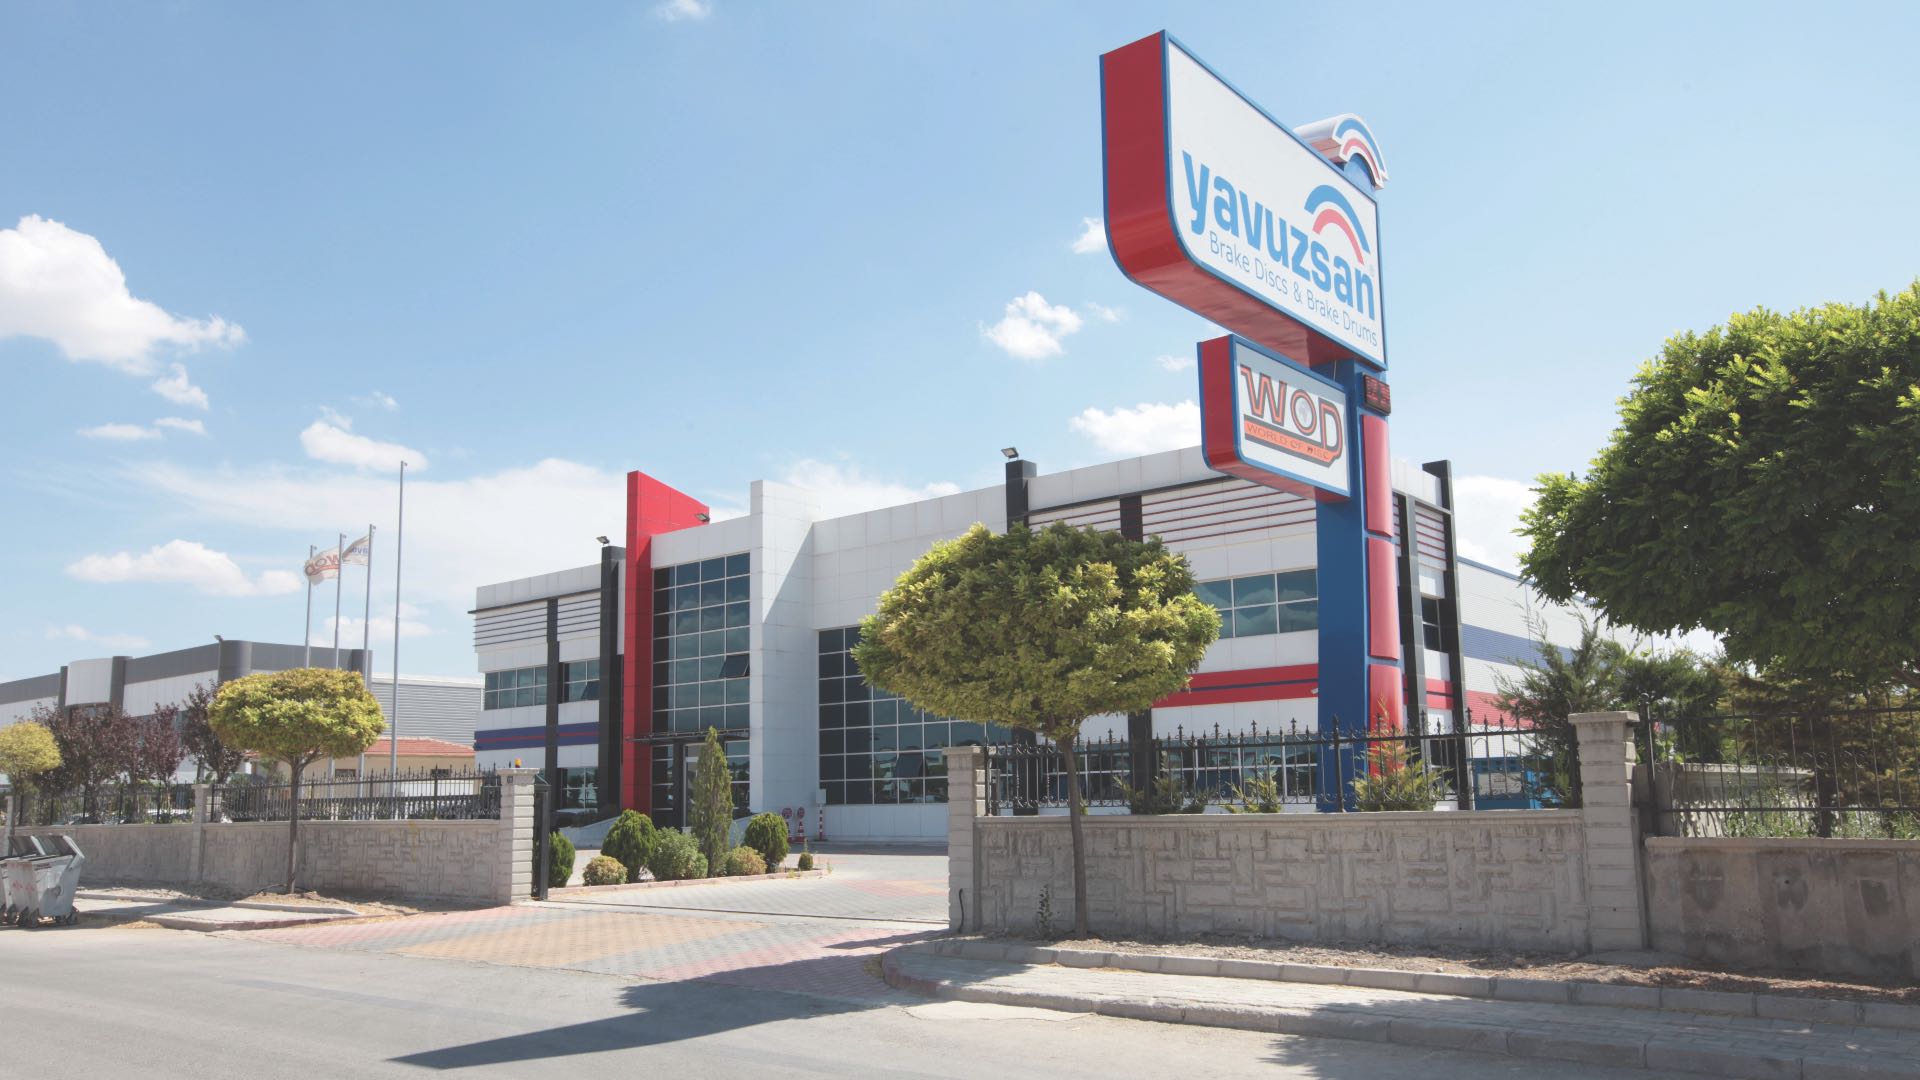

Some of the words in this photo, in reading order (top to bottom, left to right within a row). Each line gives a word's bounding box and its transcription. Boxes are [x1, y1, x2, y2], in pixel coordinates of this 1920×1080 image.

[1182, 150, 1375, 321] yavuzsan
[1209, 231, 1251, 273] Brake
[1255, 257, 1289, 295] Discs
[1293, 281, 1303, 303] &
[1307, 289, 1340, 326] Brake
[1342, 310, 1378, 347] Drums
[1240, 364, 1343, 458] WOD
[1246, 423, 1288, 444] WORLD
